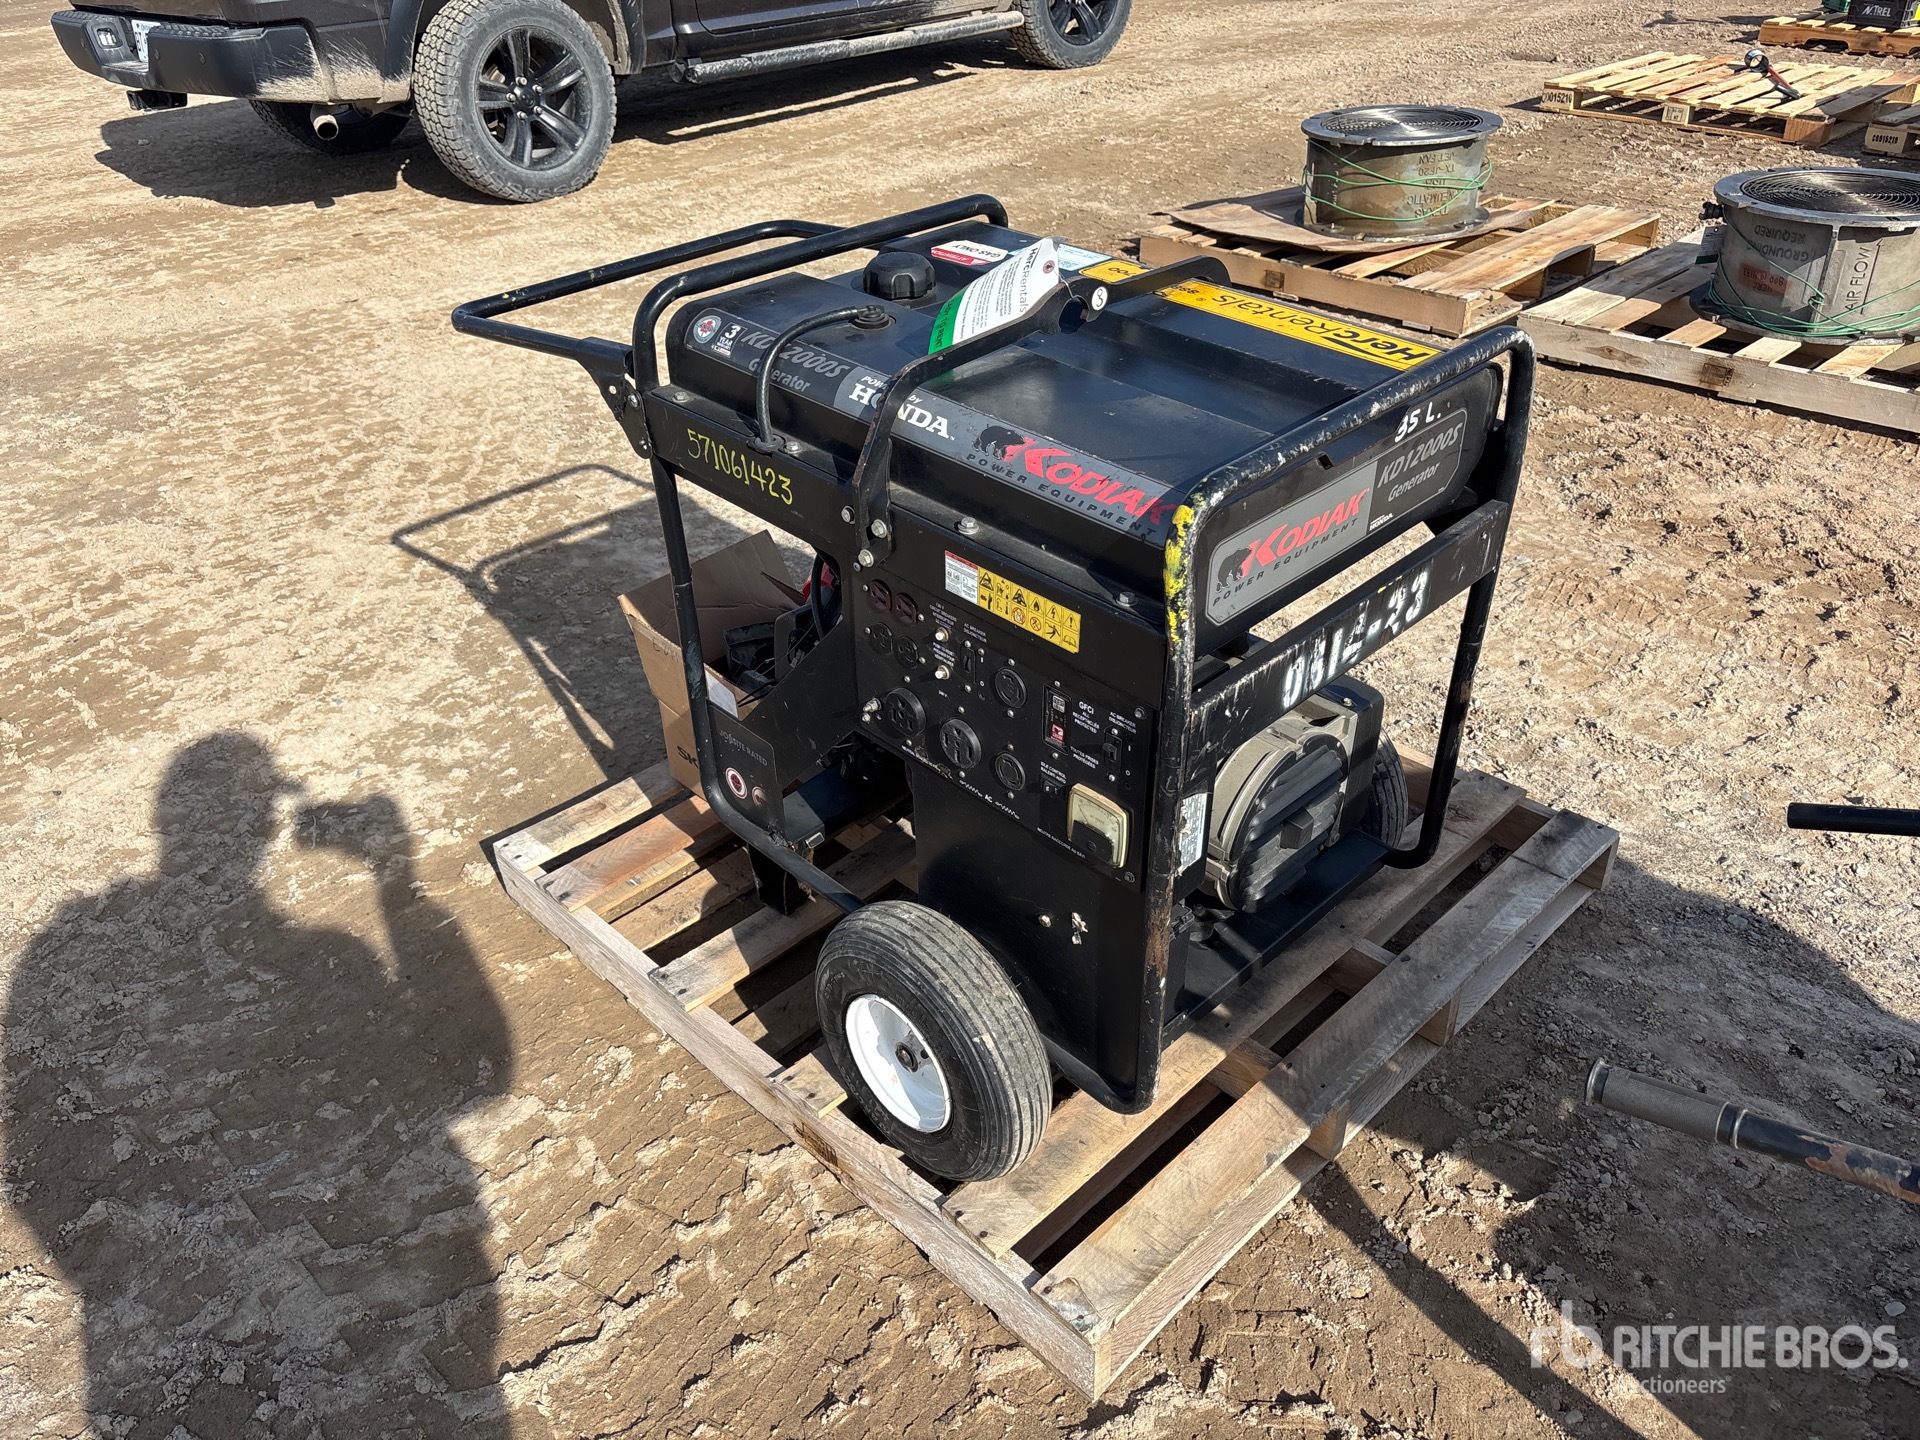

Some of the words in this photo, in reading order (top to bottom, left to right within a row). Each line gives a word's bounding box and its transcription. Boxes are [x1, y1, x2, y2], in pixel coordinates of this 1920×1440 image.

[1407, 190, 1459, 206] NEUMATIC
[1754, 224, 1807, 243] REQUIRED
[1850, 246, 1873, 290] FLOW
[724, 325, 742, 339] 3
[1211, 293, 1431, 362] HercRentals
[740, 331, 850, 378] KD2000S
[748, 358, 812, 393] Gerator
[687, 428, 793, 506] 571061423
[1376, 422, 1464, 489] KD12000S
[965, 453, 1028, 484] POWER
[1037, 483, 1158, 537] EQUIPMENT
[1003, 436, 1178, 525] KODIAK
[1387, 461, 1441, 502] Generator
[1237, 488, 1370, 580] KODIAK
[1369, 512, 1395, 531] HONDA
[1212, 571, 1266, 607] POWER
[1273, 517, 1359, 570] EQUIPMENT
[1078, 701, 1094, 714] GFCI
[746, 746, 768, 767] RATED
[984, 793, 993, 803] AC
